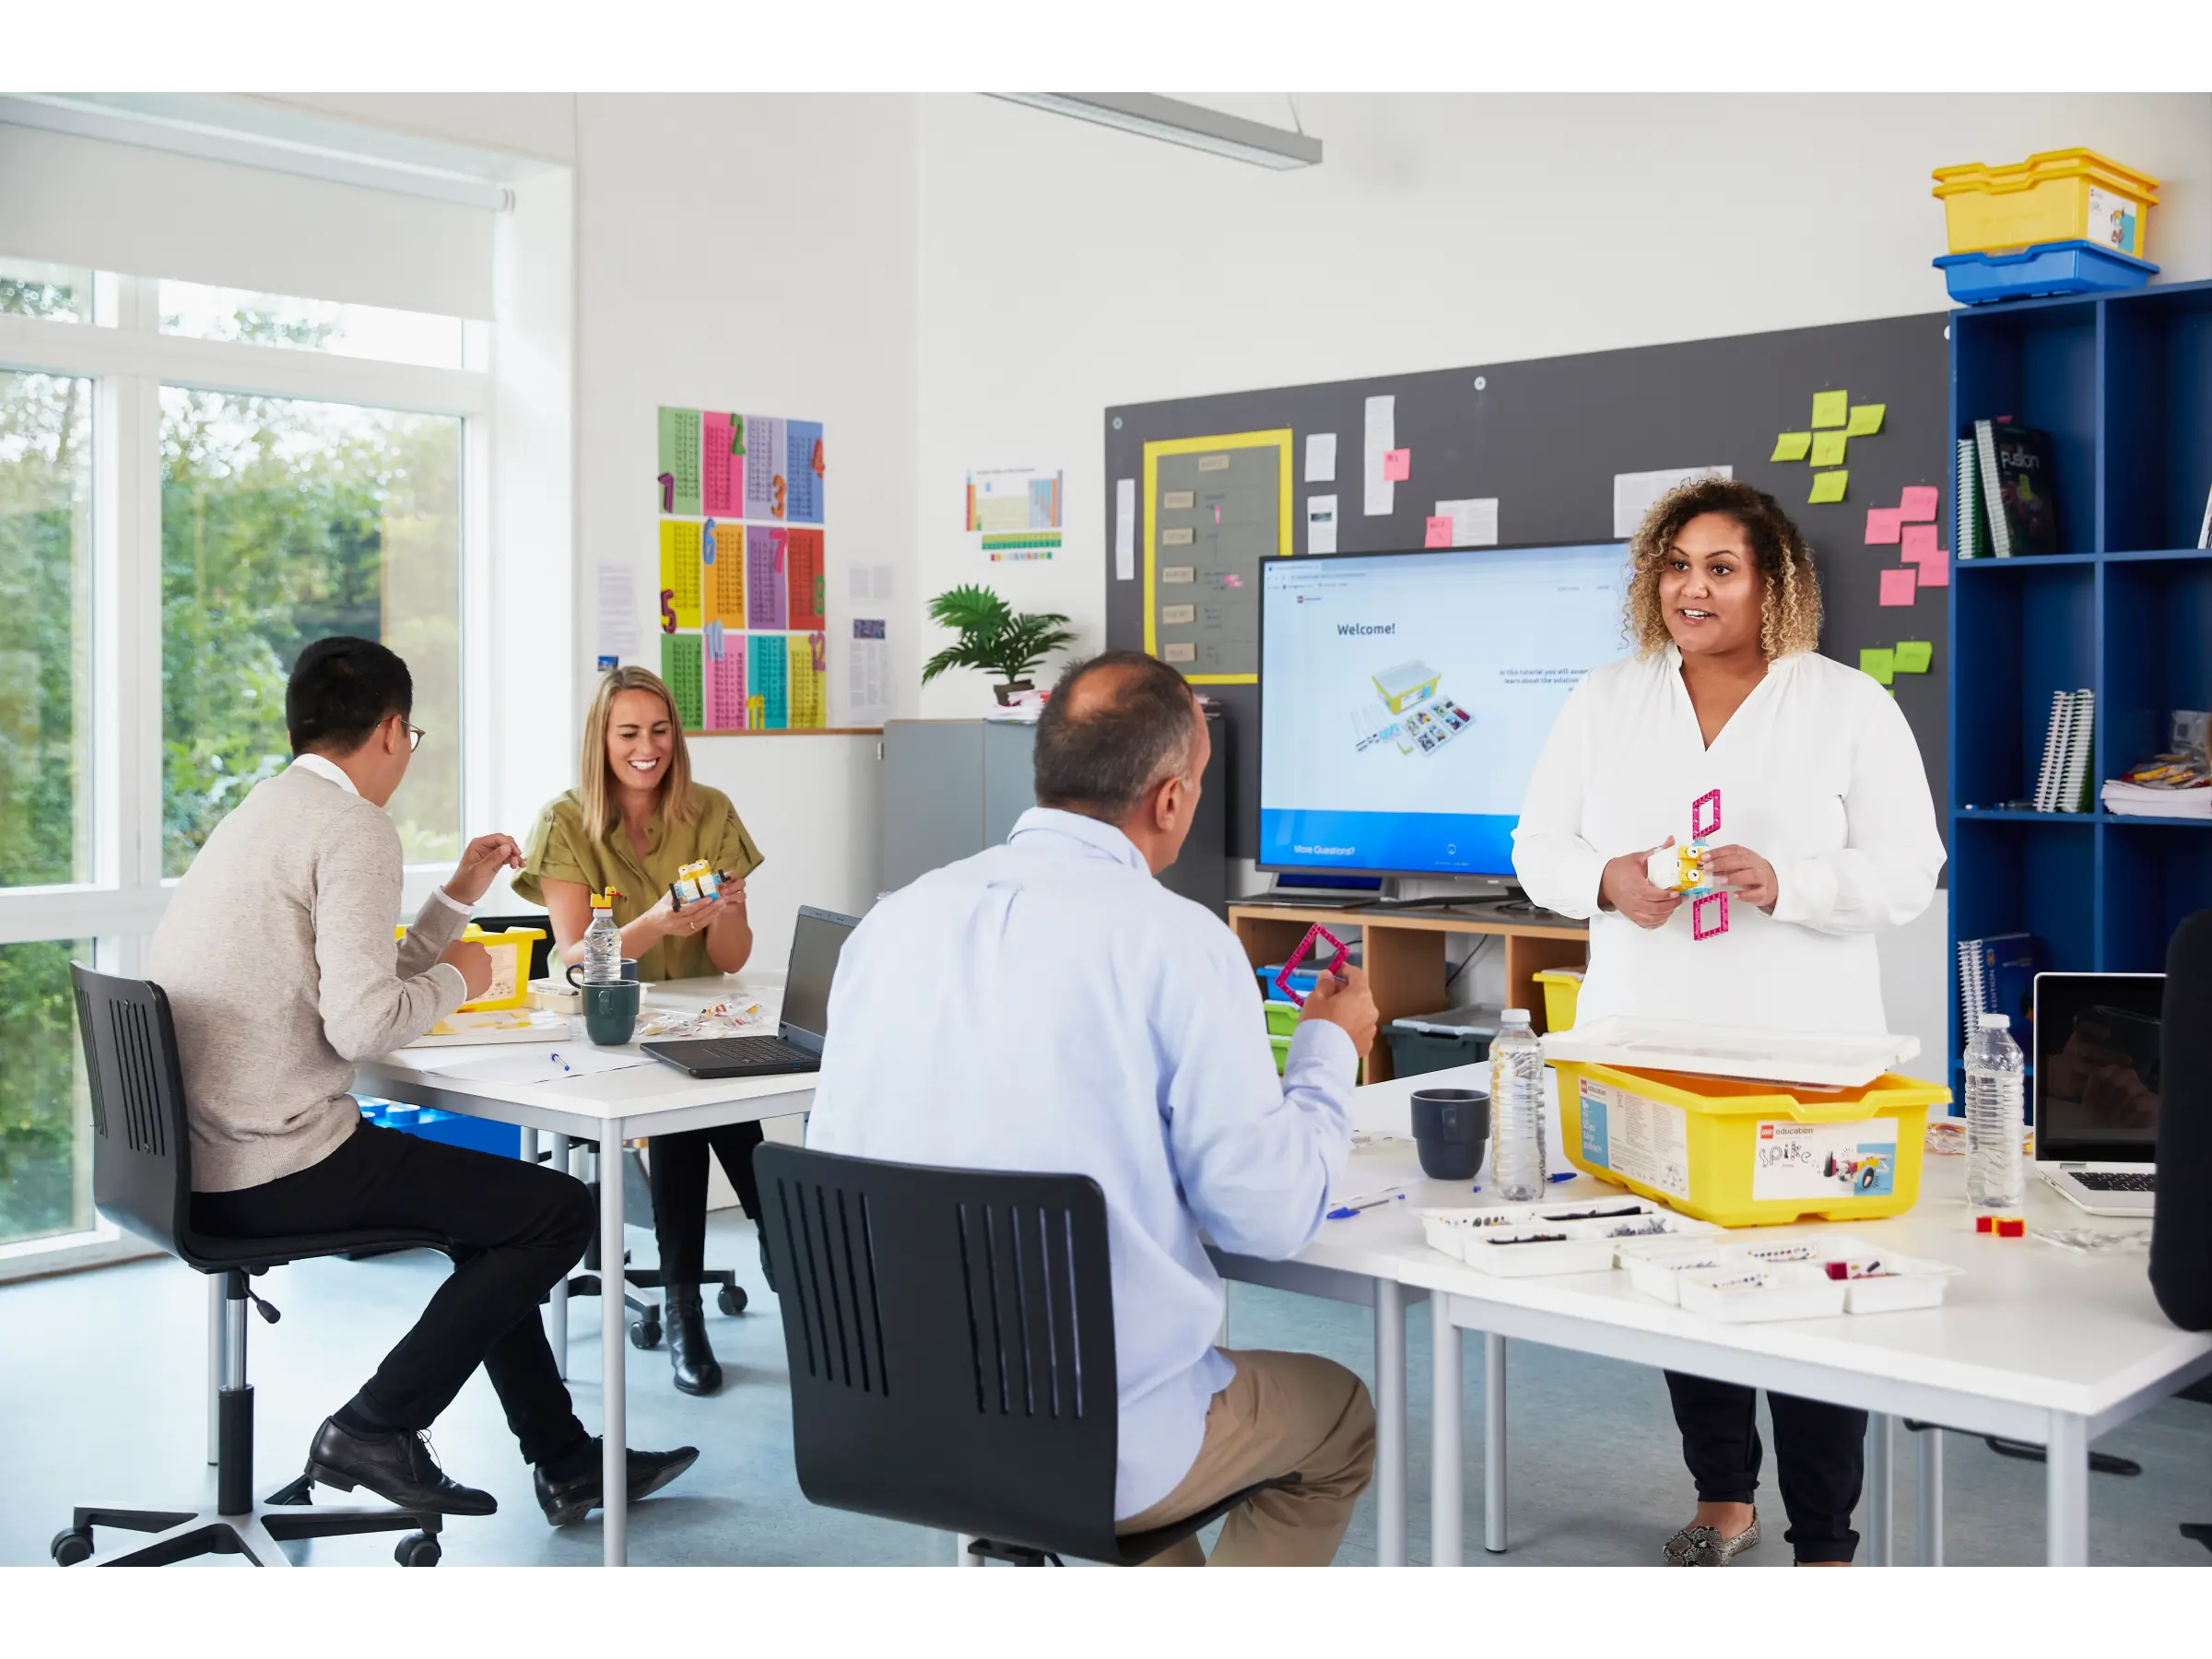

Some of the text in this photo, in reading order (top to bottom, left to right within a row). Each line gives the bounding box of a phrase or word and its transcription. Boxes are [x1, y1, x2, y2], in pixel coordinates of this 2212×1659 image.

[730, 413, 745, 455] 2
[811, 438, 825, 479] 4
[657, 472, 674, 513] 1
[771, 474, 786, 519] 3
[702, 517, 716, 565] 6
[770, 529, 788, 574] 7
[660, 589, 677, 634] 5
[815, 574, 825, 616] 8
[704, 619, 724, 660] 10
[1336, 622, 1395, 636] Welcome!
[808, 630, 826, 672] 12
[747, 693, 764, 729] 11
[1294, 845, 1356, 855] More Questions?
[1775, 1126, 1814, 1135] education
